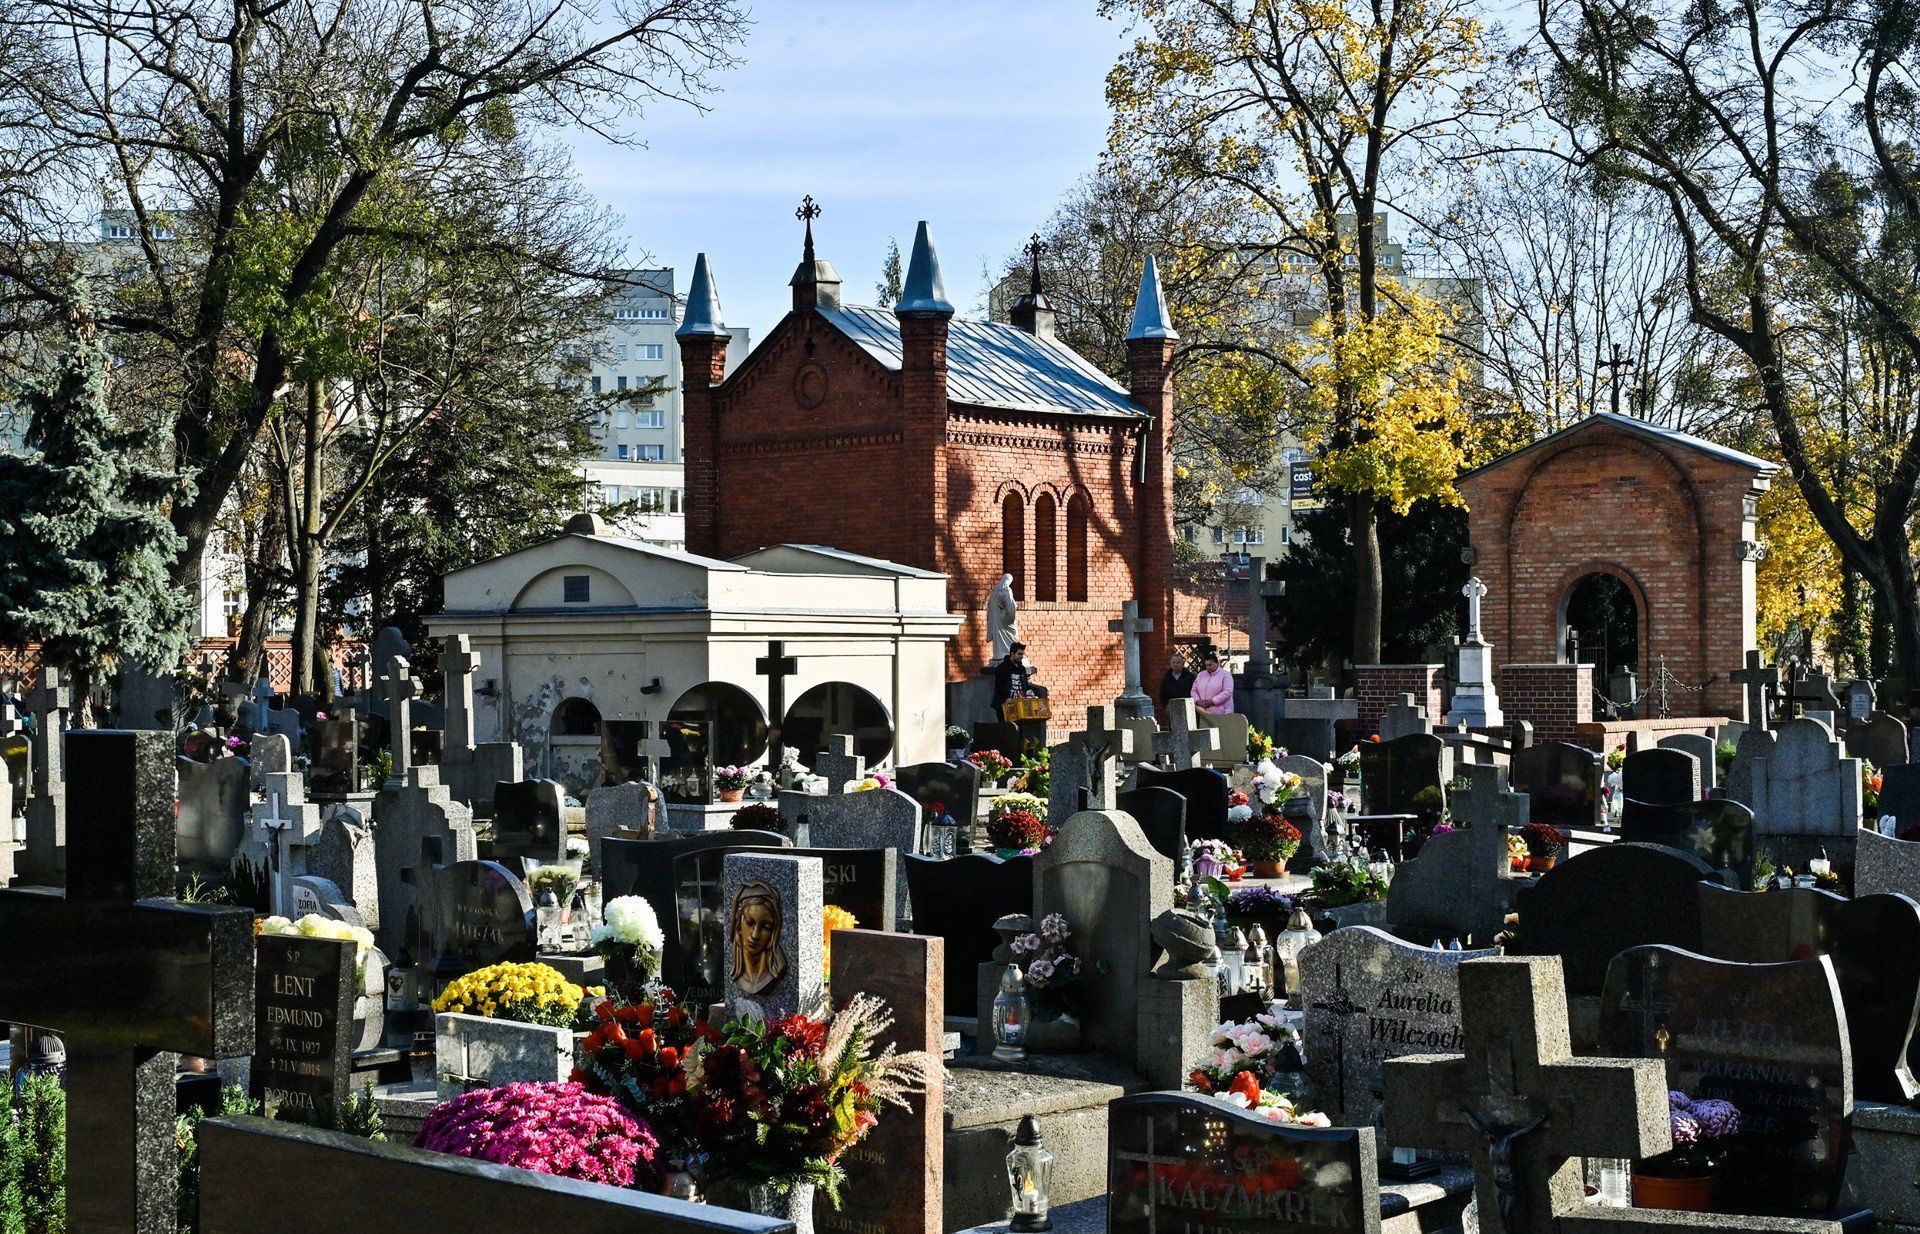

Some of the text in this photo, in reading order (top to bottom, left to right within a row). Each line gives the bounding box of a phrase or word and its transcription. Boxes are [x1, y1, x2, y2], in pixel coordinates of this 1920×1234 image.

[823, 864, 857, 883] SKI
[298, 899, 318, 911] ZOFIA
[1377, 988, 1454, 1014] Aurelia
[266, 1006, 323, 1029] EDMUND
[1369, 1017, 1465, 1050] Wilczoch
[301, 1040, 321, 1054] 1927
[1696, 1060, 1798, 1085] MARIANNA
[263, 1087, 315, 1110] DOROTA
[1159, 1174, 1350, 1230] KACZMAREK
